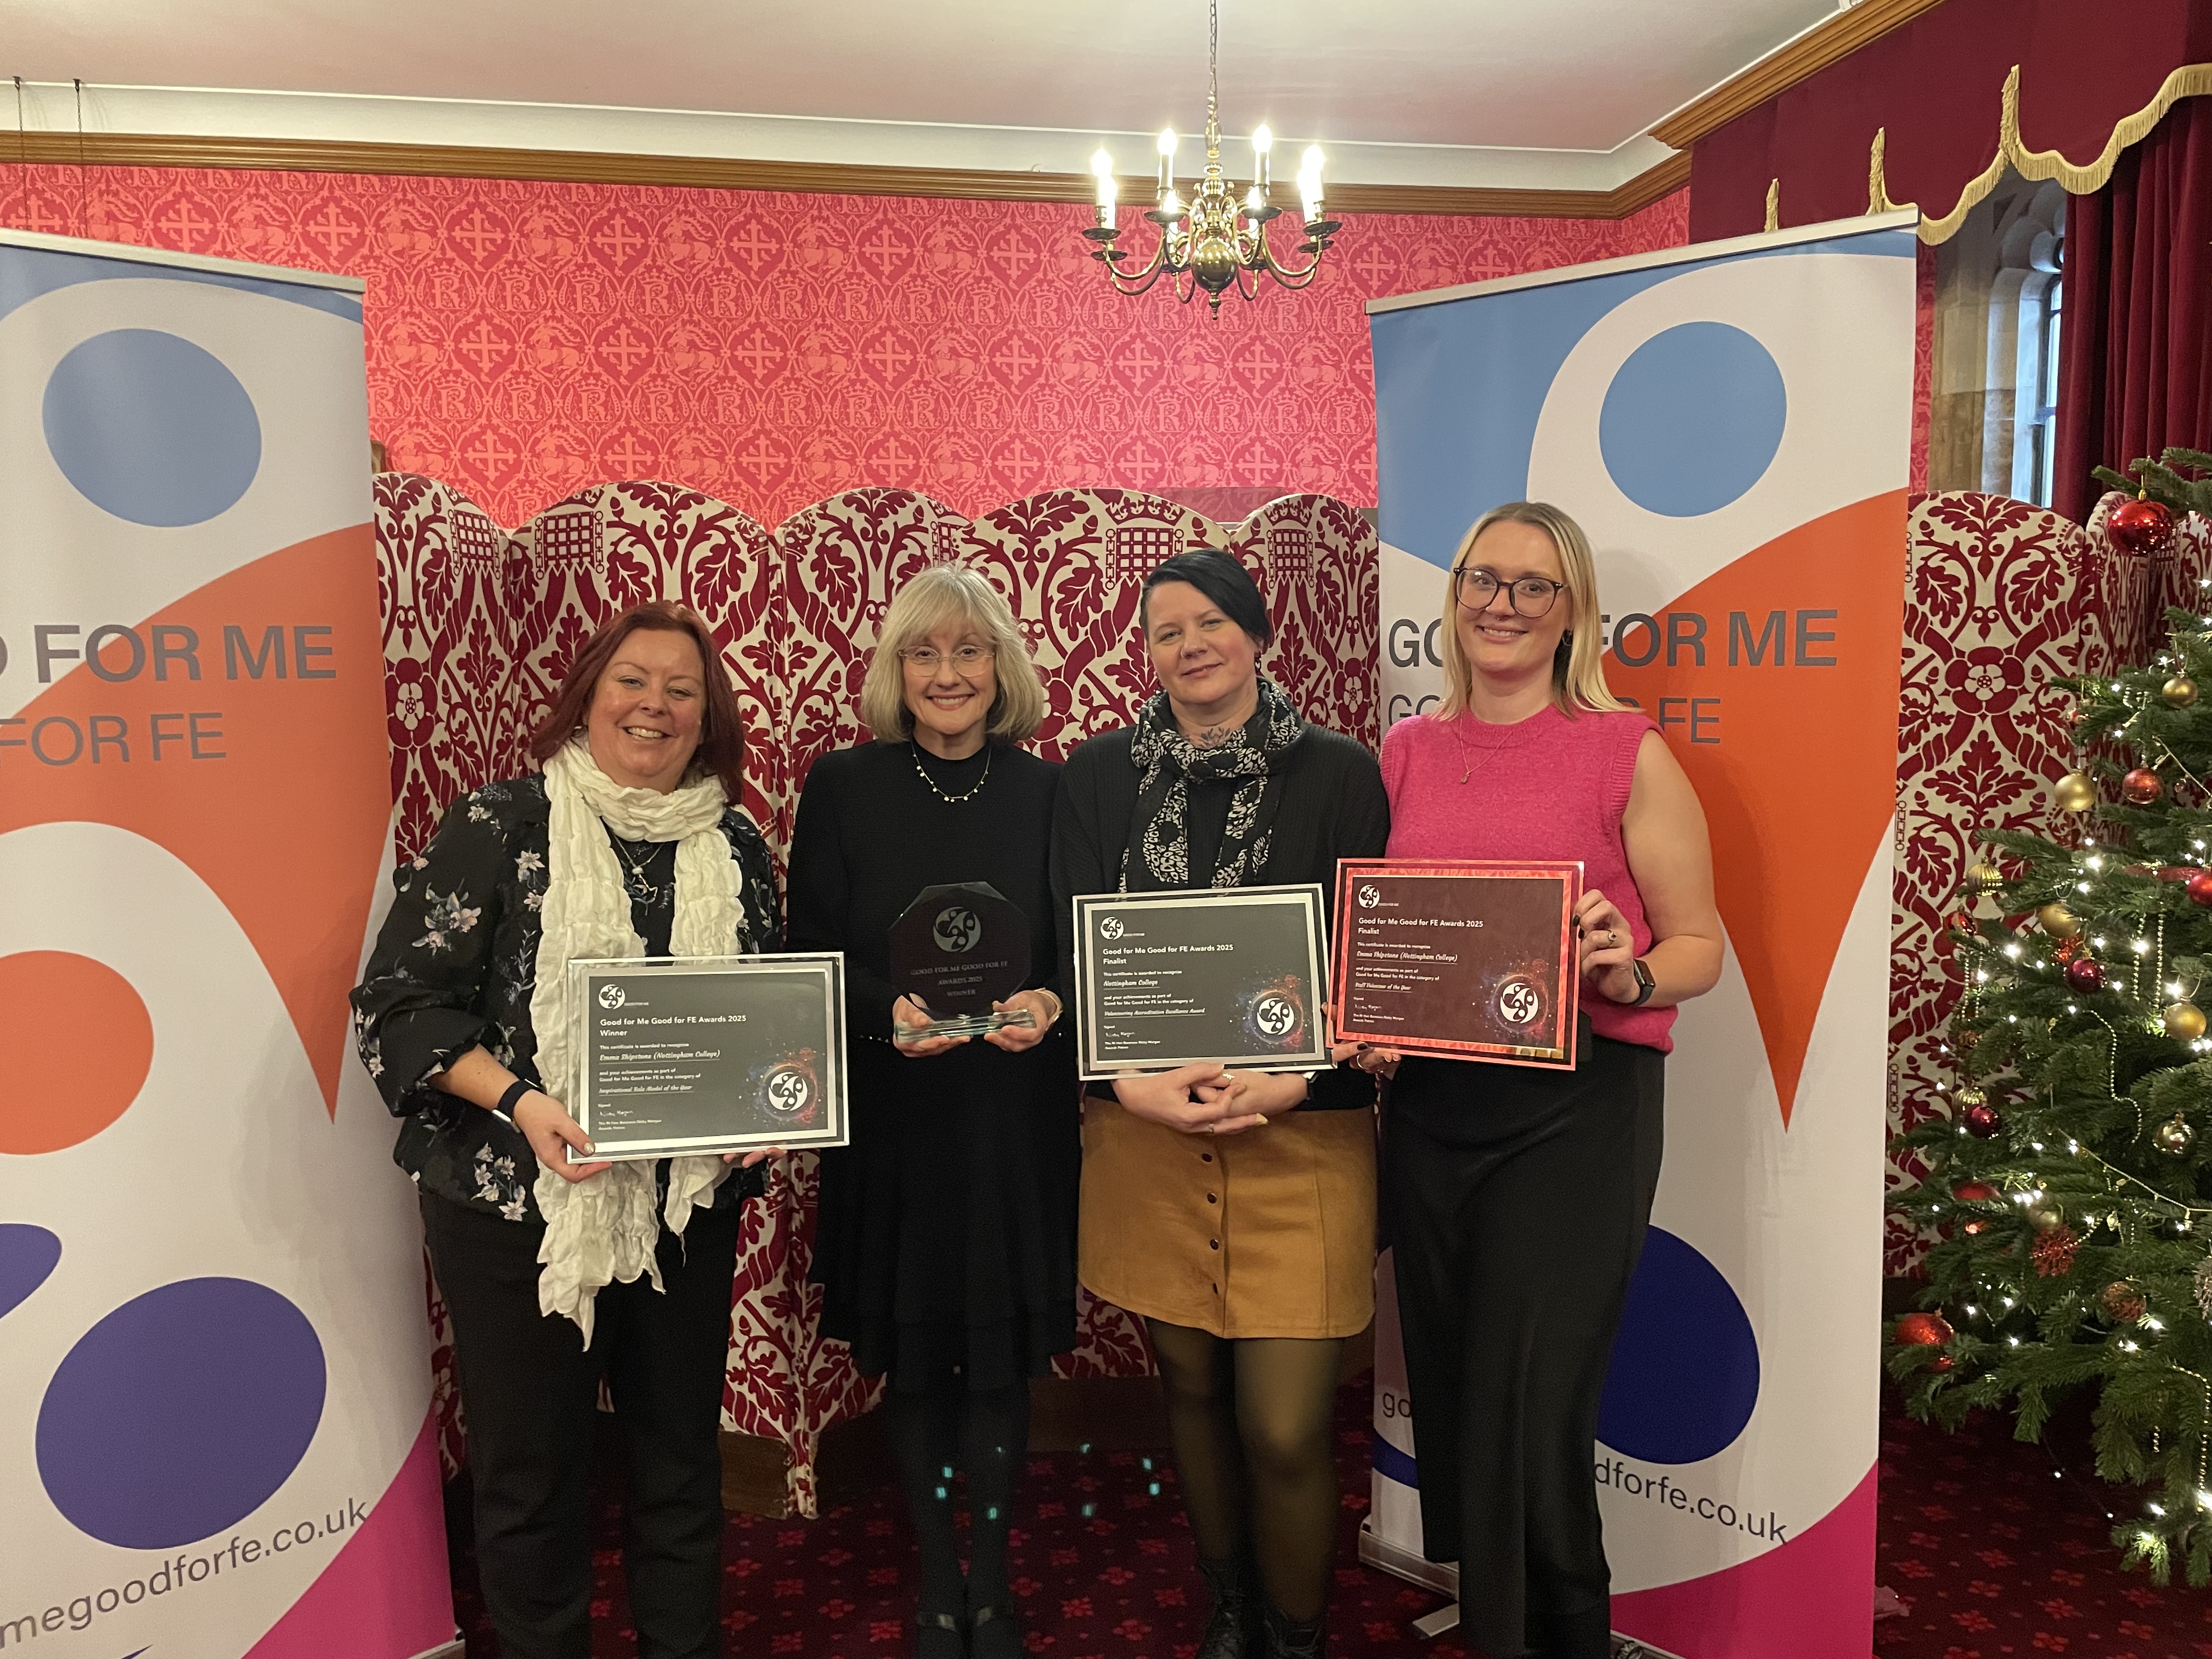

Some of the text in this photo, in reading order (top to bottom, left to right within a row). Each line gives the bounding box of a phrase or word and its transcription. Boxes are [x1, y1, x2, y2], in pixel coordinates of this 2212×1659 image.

[34, 624, 201, 684] FOR
[223, 625, 336, 681] ME
[1601, 613, 1707, 667] OR
[1729, 610, 1838, 667] ME
[151, 713, 227, 761] FE
[1659, 697, 1720, 743] FE
[939, 977, 967, 985] AWARDS
[1436, 954, 1458, 962] College)
[695, 1049, 720, 1058] College)
[0, 1498, 367, 1649] megoodforfe.co.uk
